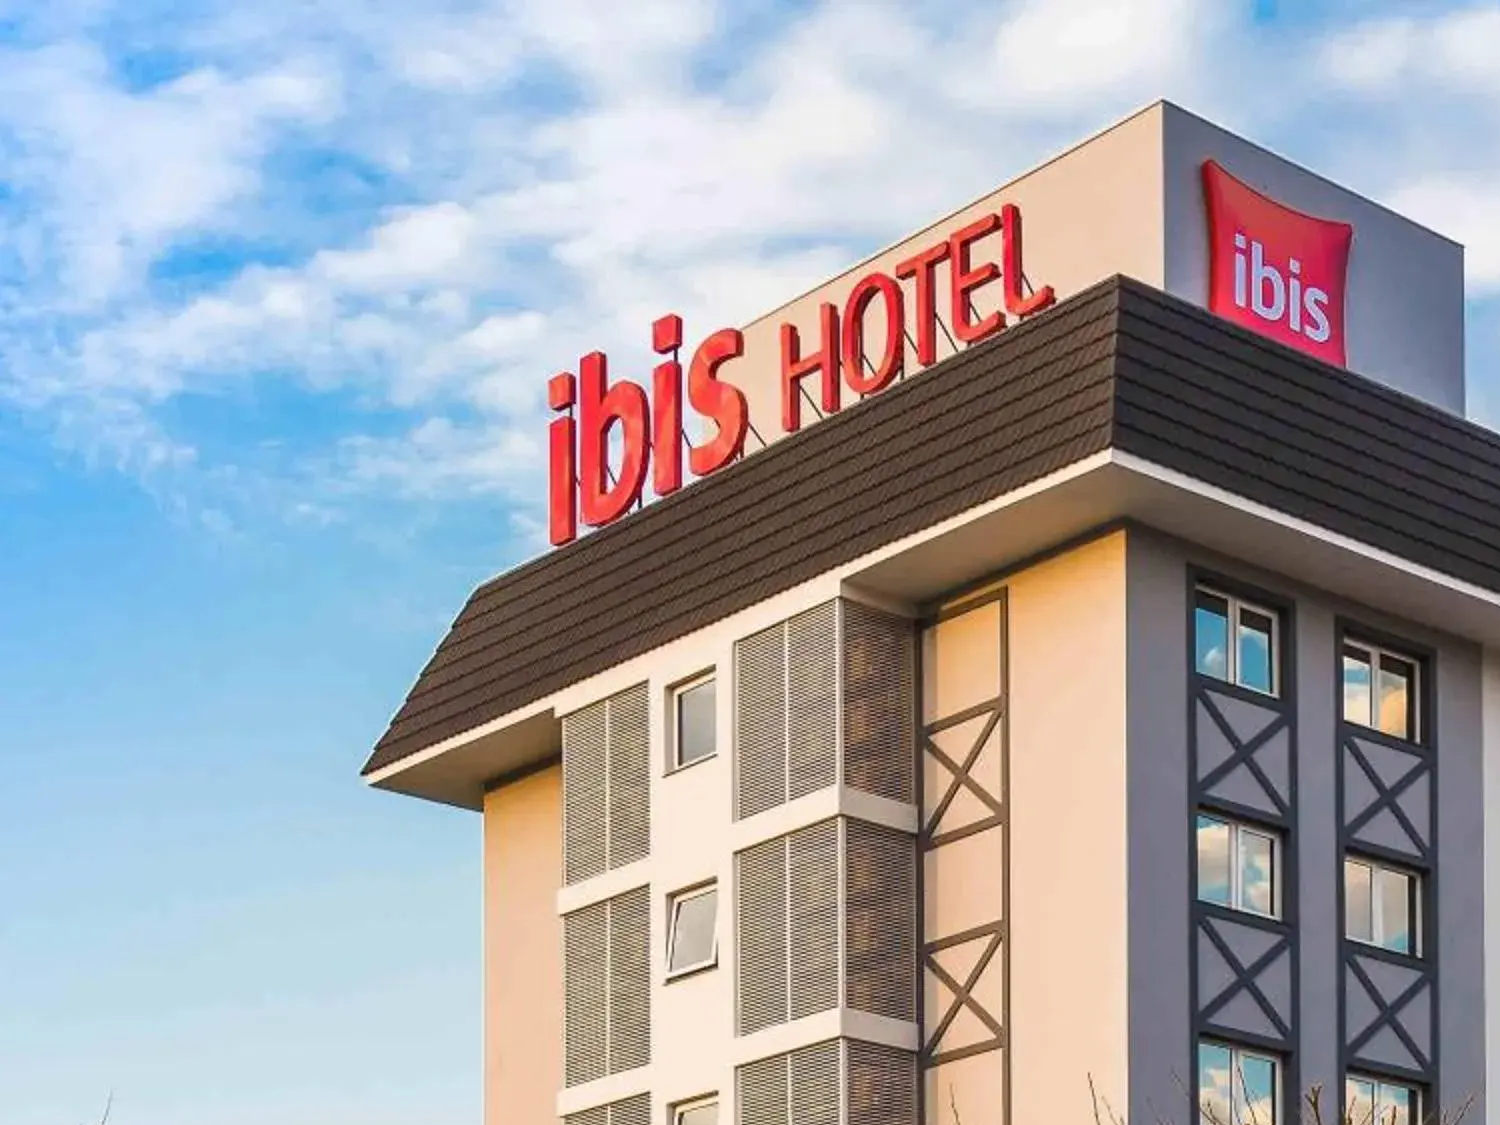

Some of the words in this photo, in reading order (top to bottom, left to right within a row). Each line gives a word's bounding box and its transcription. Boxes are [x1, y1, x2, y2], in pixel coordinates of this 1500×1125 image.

[548, 314, 749, 546] ibis
[780, 203, 1056, 433] HOTEL
[1234, 232, 1330, 343] ibis
